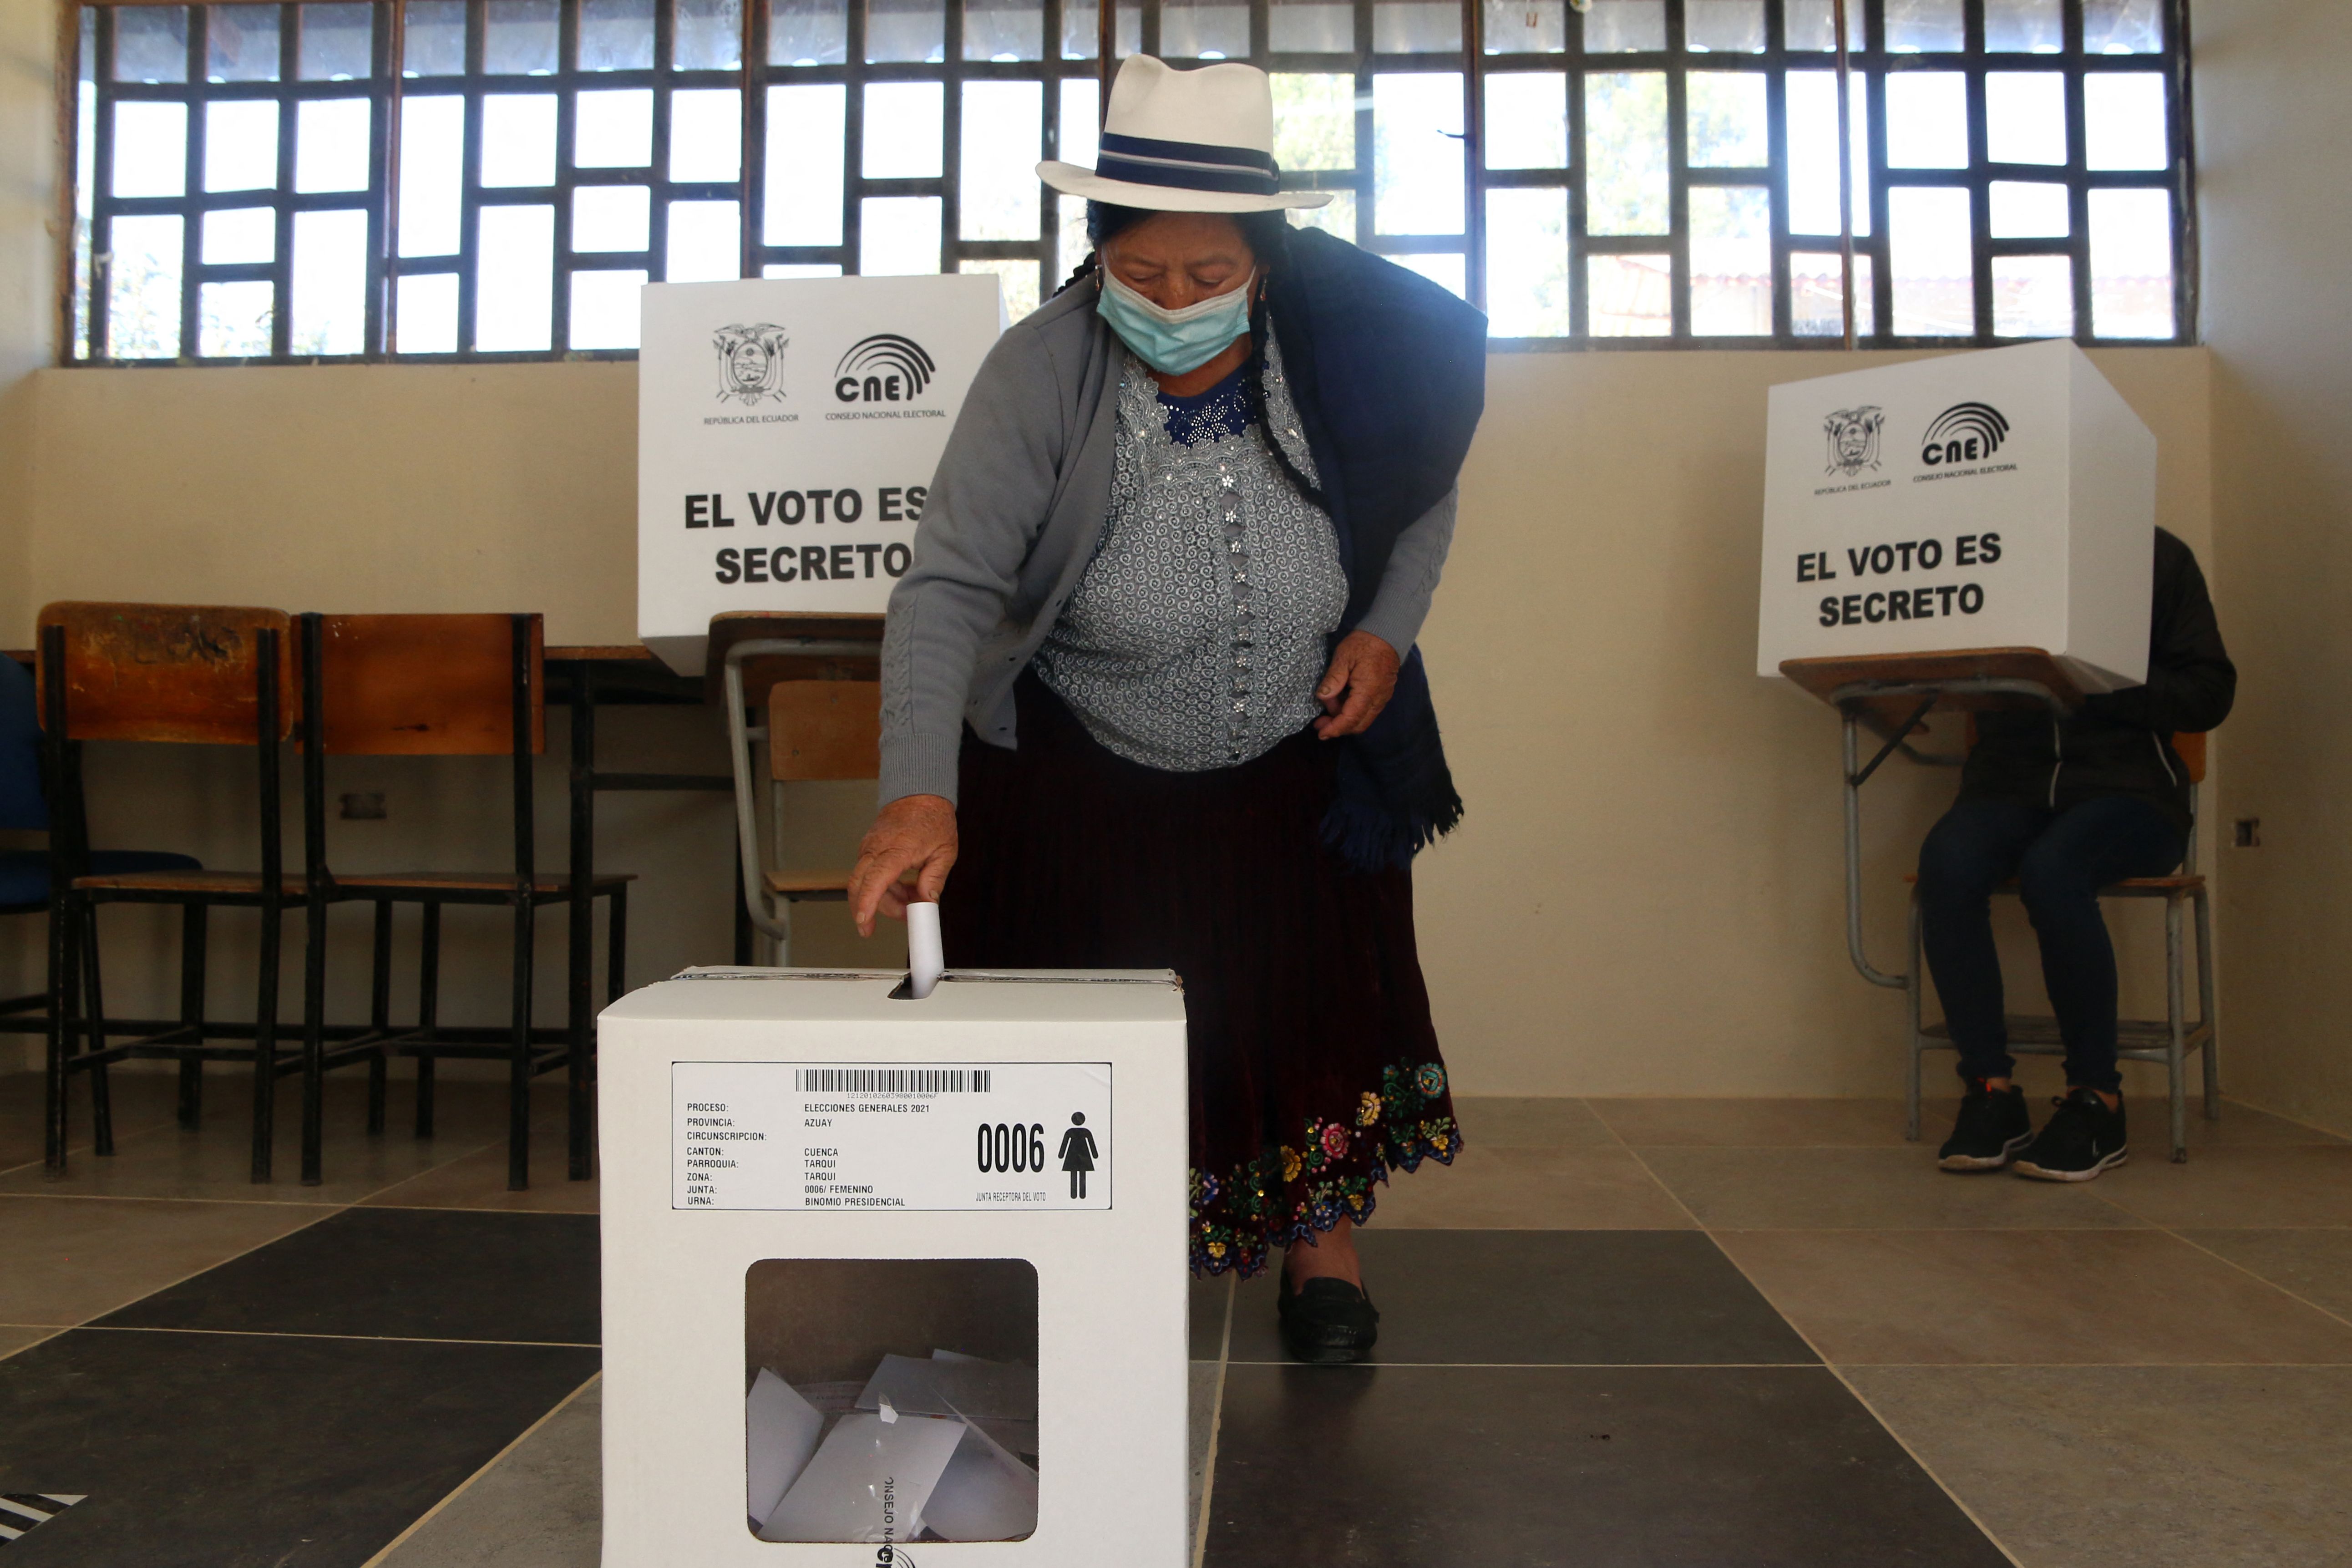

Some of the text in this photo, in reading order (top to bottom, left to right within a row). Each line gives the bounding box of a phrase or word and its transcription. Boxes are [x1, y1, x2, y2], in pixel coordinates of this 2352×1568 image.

[836, 376, 900, 402] CNE
[747, 416, 760, 424] DEL
[762, 415, 799, 423] ECUADOR
[826, 409, 946, 421] CONSEJO NACIONAL ELECTORAL
[1922, 438, 1977, 465] CNE
[1913, 463, 2018, 483] CONSEJO NACIONAL ELECTORAL
[1848, 483, 1859, 491] DEL
[1861, 479, 1891, 489] ECUADOR
[685, 486, 928, 529] EL VOTO ES
[1797, 532, 2002, 583] EL VOTO ES
[715, 543, 912, 584] SECRETO
[1819, 583, 1984, 627] SECRETO
[687, 1103, 729, 1112] PROCESO:
[804, 1103, 930, 1113] ELECCIONES GENERALES 2021
[687, 1118, 735, 1127] PROVINCIA:
[804, 1118, 833, 1127] AZUAY
[687, 1132, 767, 1141] CIRCUNSCRIPCION:
[687, 1147, 724, 1156] CANTON:
[804, 1148, 839, 1157] CUENCA
[978, 1123, 1044, 1173] 0006
[687, 1159, 739, 1168] PARROQUIA:
[805, 1159, 836, 1168] TARQUI
[687, 1172, 712, 1181] ZONA:
[805, 1172, 836, 1181] TARQUI
[687, 1185, 717, 1194] JUNTA:
[805, 1185, 873, 1193] 0006/ FEMENINO
[688, 1197, 714, 1205] URNA:
[976, 1192, 1046, 1202] JUNTA RECEPTORA DEL VOTO
[805, 1198, 906, 1206] BINOMIO PRESIDENCIAL
